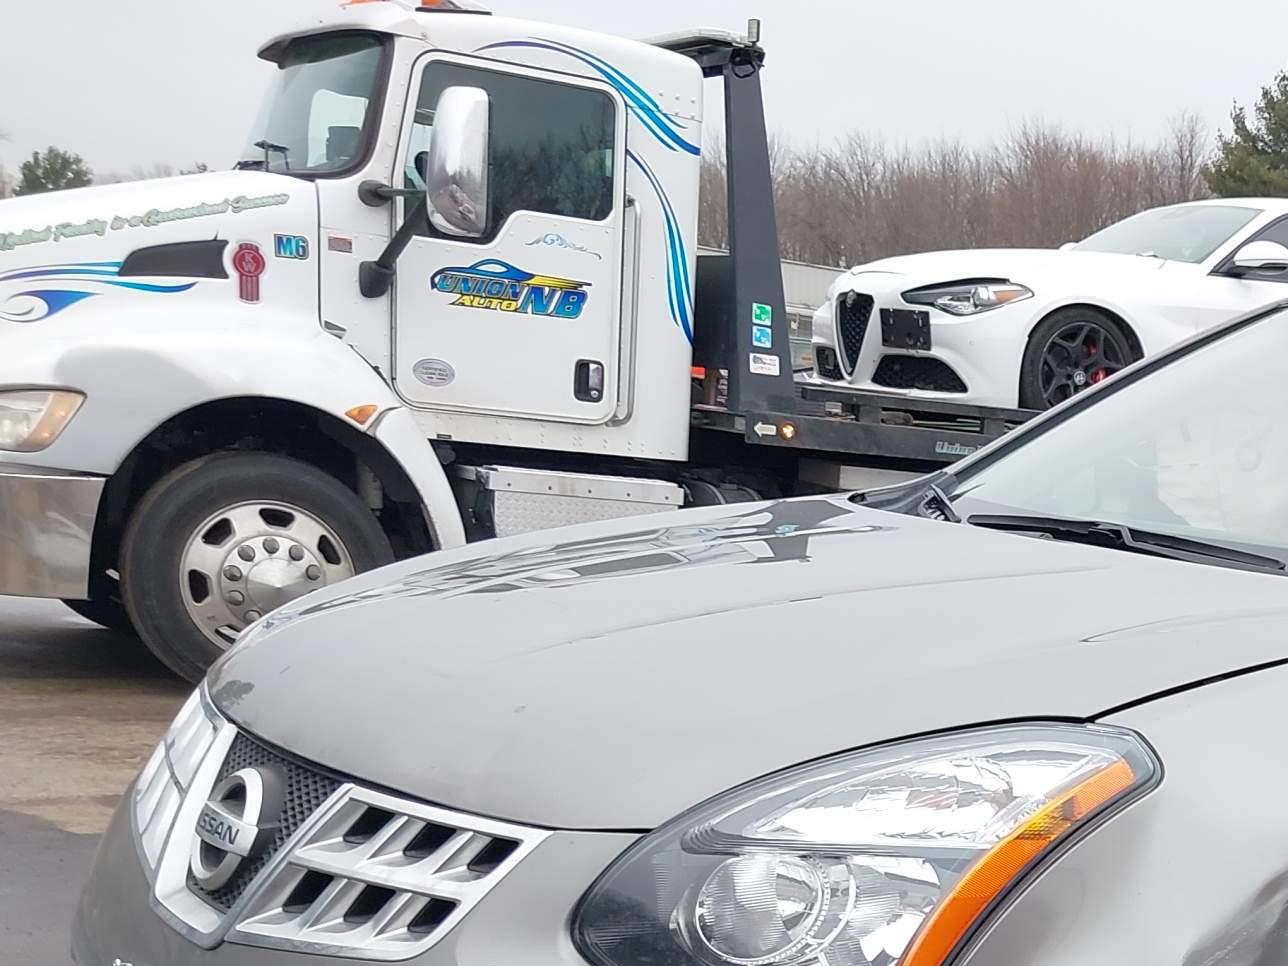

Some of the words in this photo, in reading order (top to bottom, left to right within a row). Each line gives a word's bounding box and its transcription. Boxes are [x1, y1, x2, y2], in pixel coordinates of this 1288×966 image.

[274, 234, 309, 260] M6
[435, 274, 525, 300] UNION
[518, 284, 588, 319] NB
[453, 294, 518, 312] AUTO
